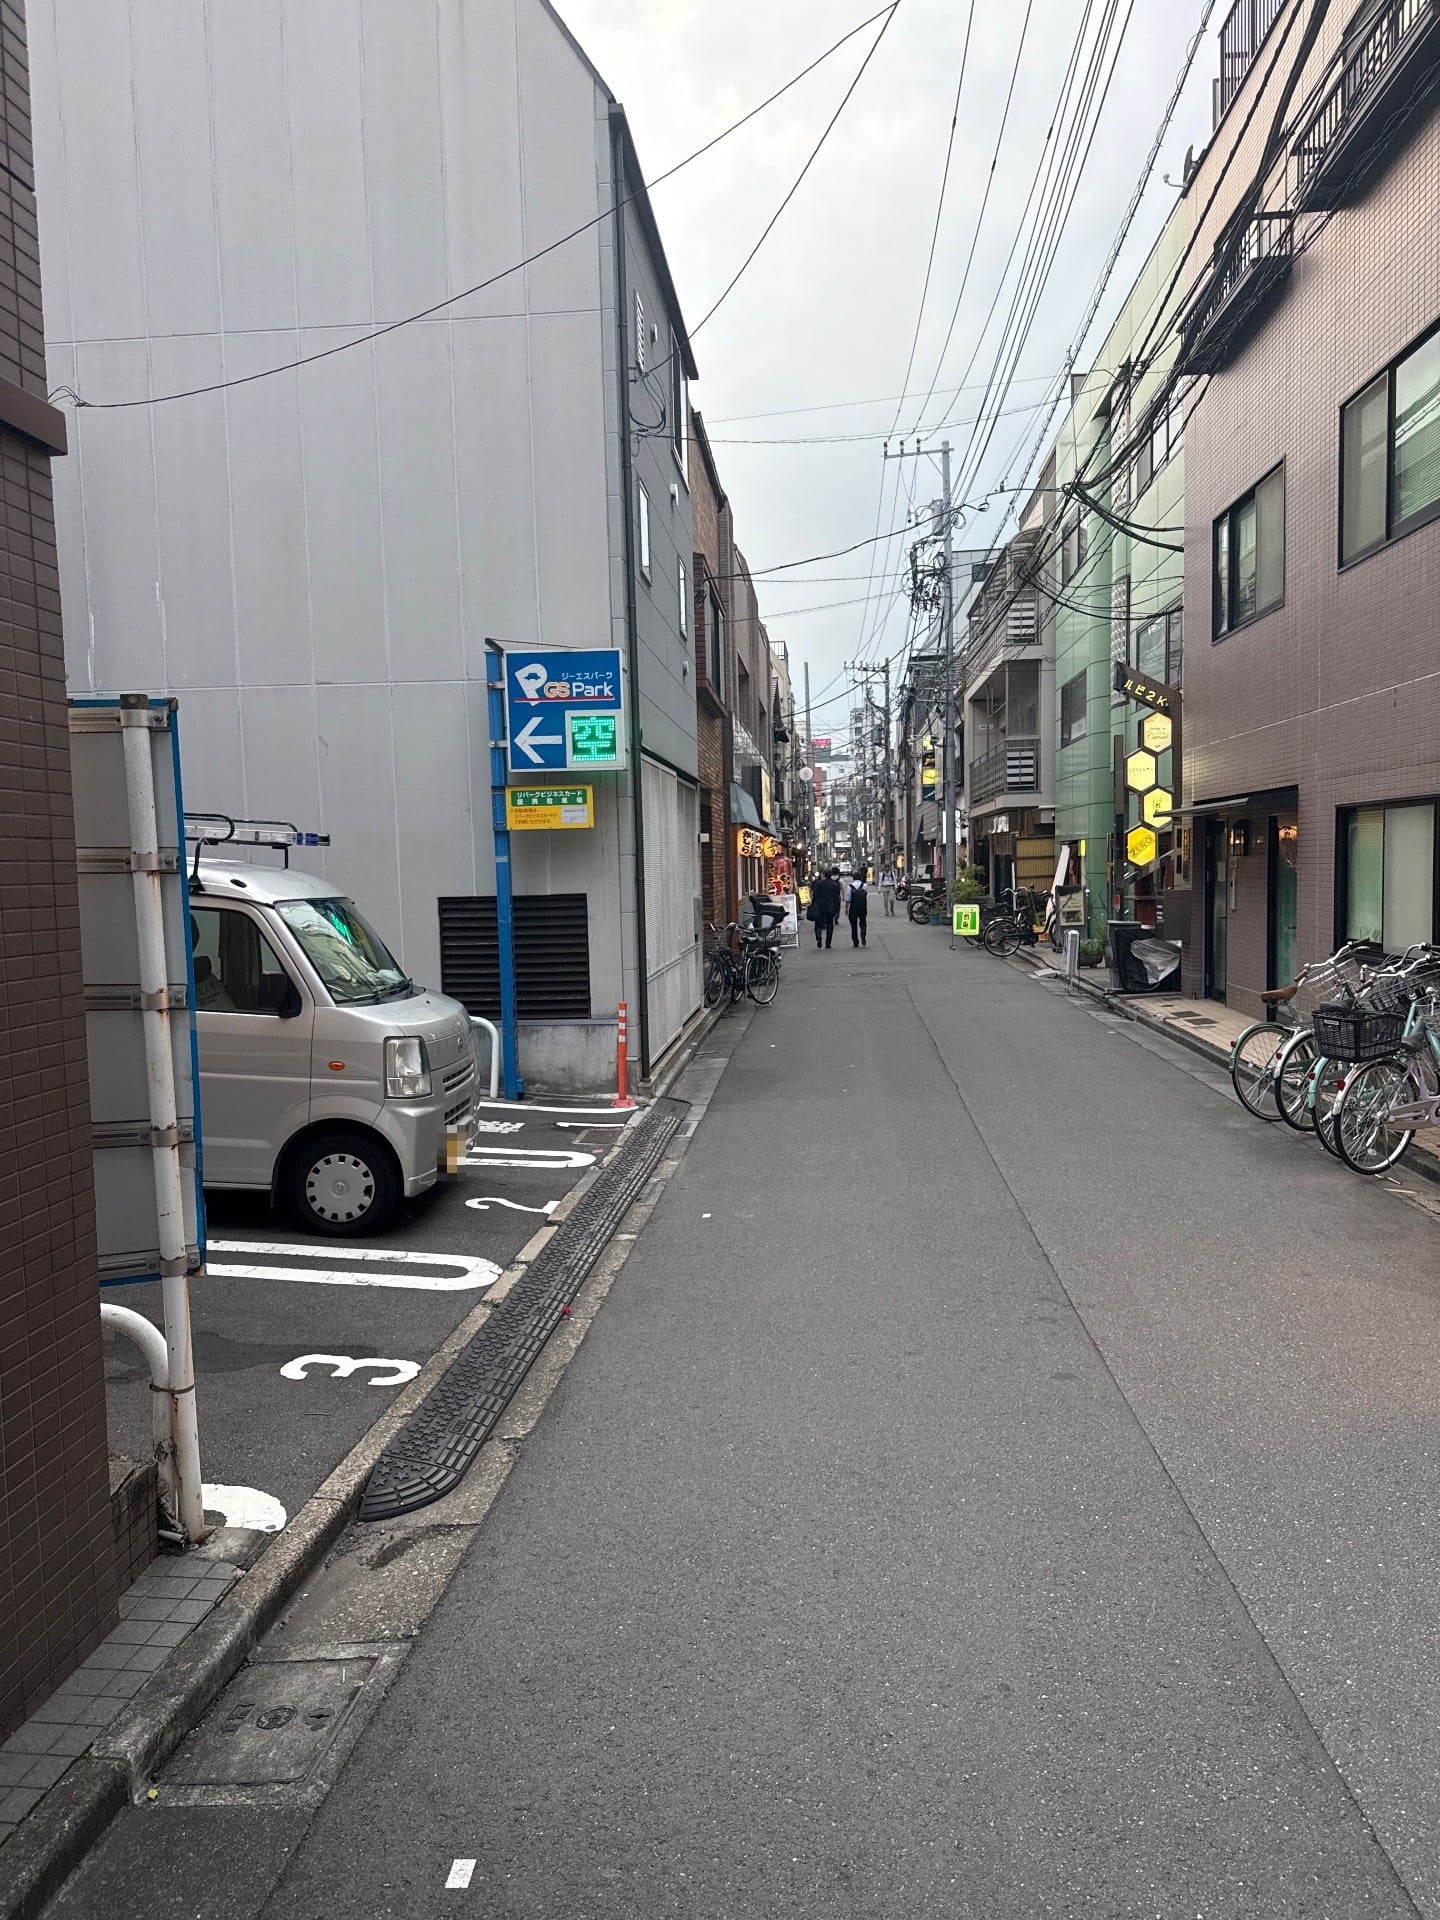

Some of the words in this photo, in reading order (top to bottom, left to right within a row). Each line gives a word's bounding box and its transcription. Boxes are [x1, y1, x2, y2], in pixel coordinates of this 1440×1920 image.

[561, 671, 613, 681] ジーエスパーク
[543, 681, 571, 699] GS
[572, 681, 614, 698] Park
[571, 716, 616, 761] 空
[516, 789, 583, 799] リパークビジネスカード
[465, 1197, 562, 1214] 2
[279, 1353, 422, 1387] 3
